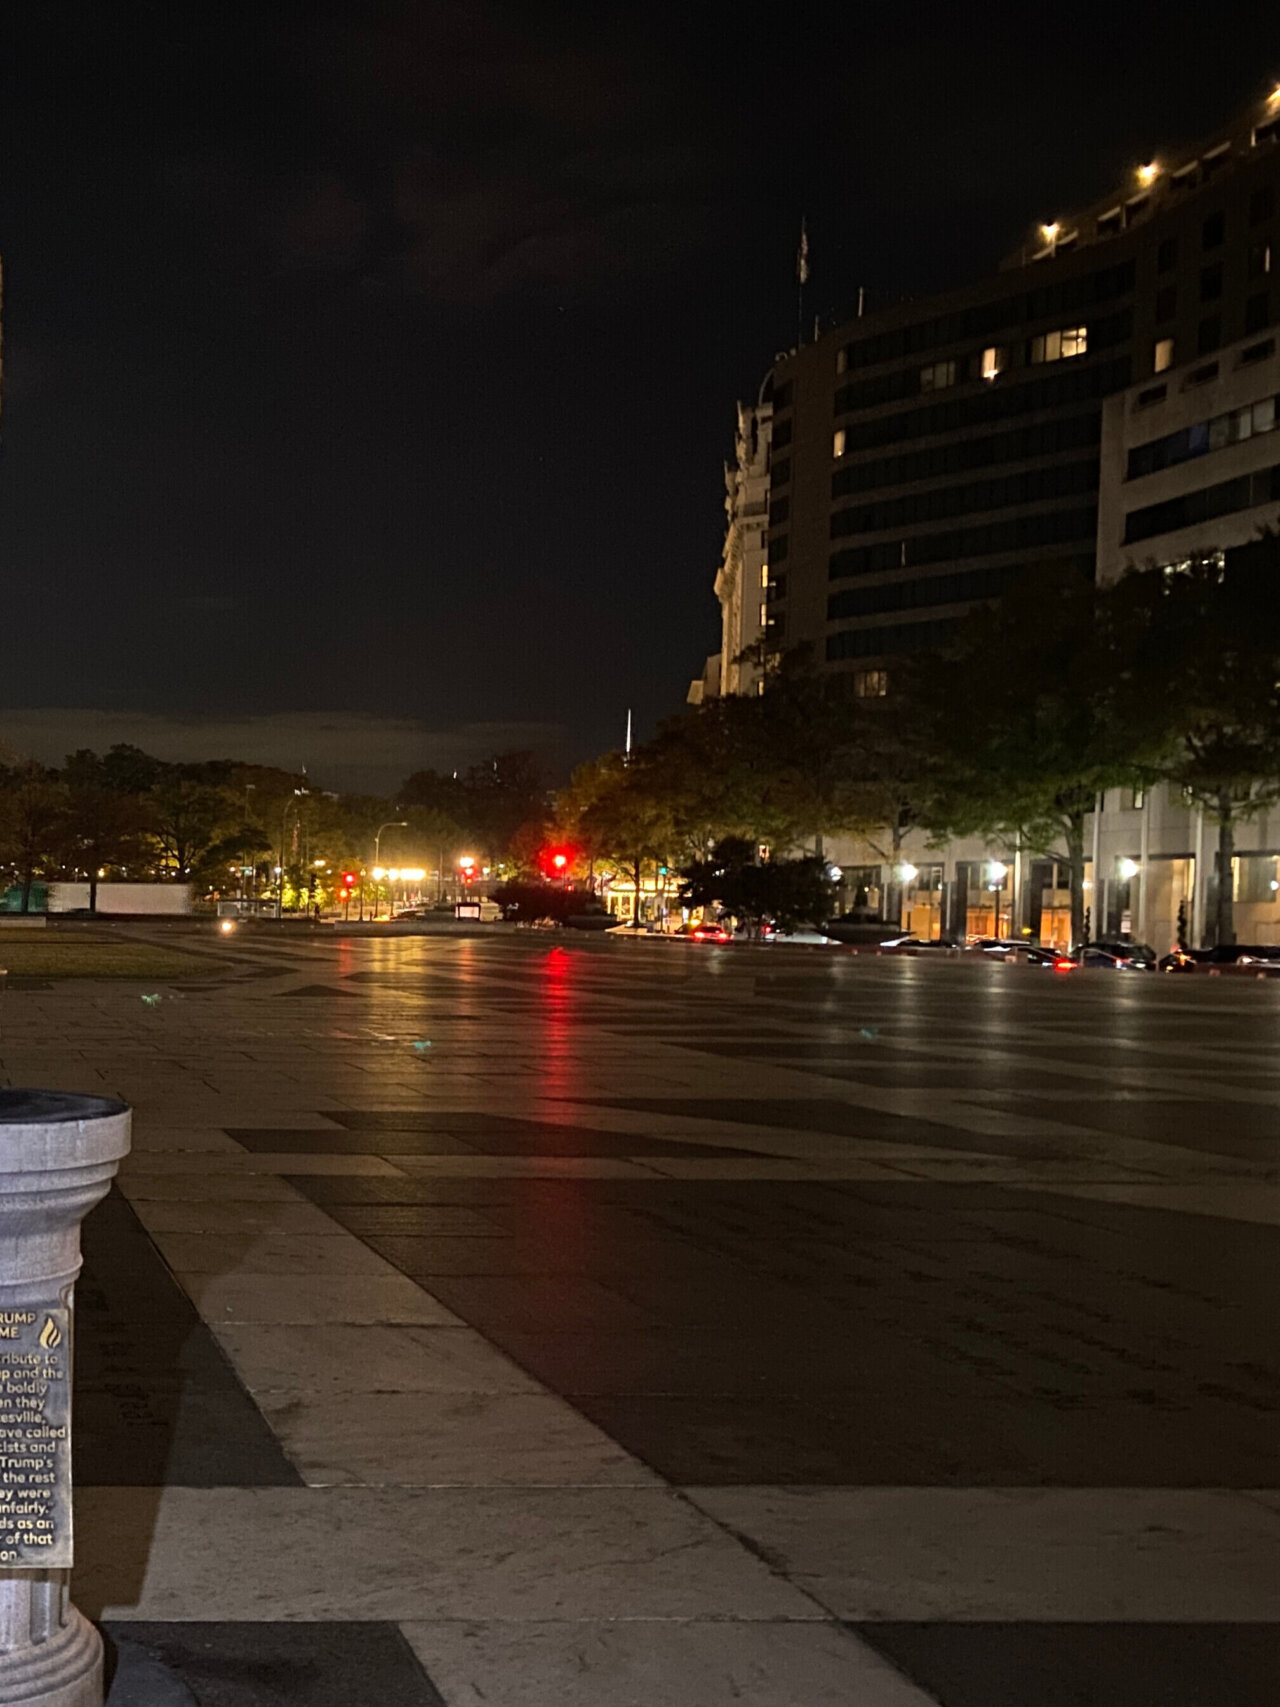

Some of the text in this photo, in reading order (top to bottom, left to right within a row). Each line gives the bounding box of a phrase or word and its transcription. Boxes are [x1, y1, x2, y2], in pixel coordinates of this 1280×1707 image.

[45, 1354, 58, 1364] to
[13, 1367, 39, 1378] and
[42, 1367, 64, 1378] the
[6, 1381, 48, 1396] boldly
[15, 1396, 45, 1411] they
[25, 1426, 66, 1438] called
[29, 1441, 55, 1453] and
[3, 1471, 26, 1483] the
[29, 1472, 55, 1483] rest
[17, 1489, 51, 1498] were
[17, 1519, 34, 1529] as
[36, 1519, 54, 1529] an
[5, 1532, 20, 1545] of
[23, 1532, 53, 1545] that
